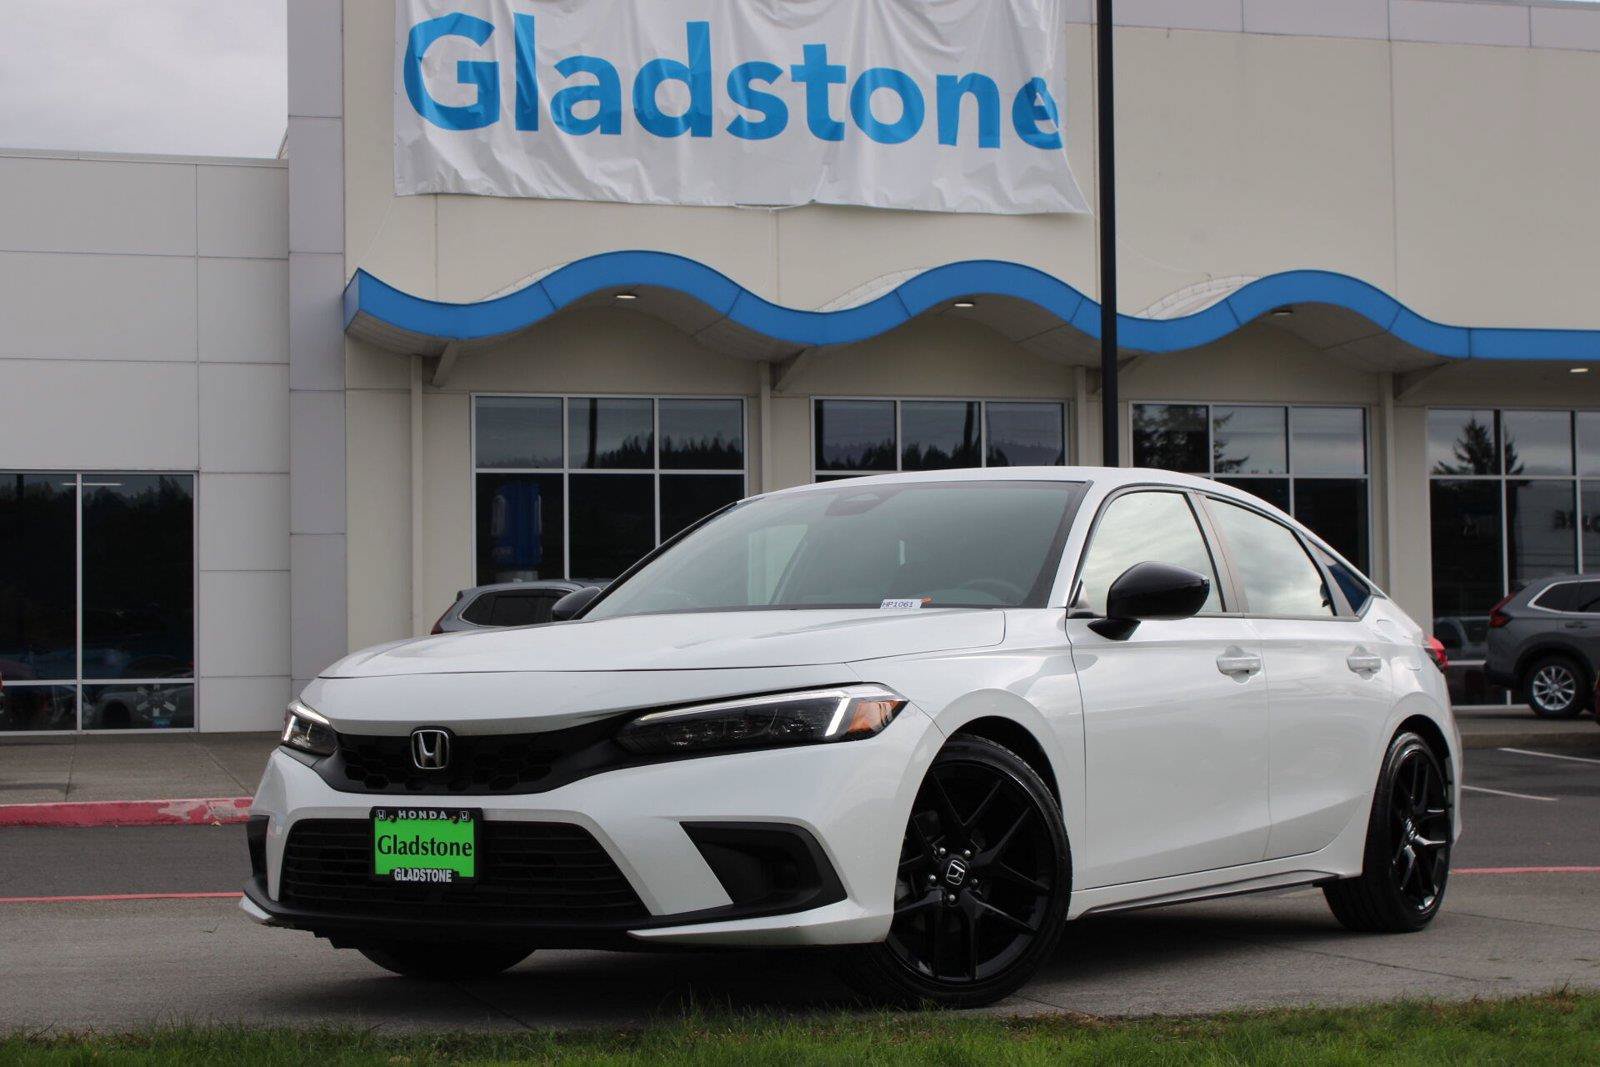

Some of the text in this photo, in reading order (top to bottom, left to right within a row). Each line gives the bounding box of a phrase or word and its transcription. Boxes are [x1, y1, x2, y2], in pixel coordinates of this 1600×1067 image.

[404, 12, 1063, 150] Gladstone
[398, 810, 448, 820] HONDA
[377, 834, 473, 857] Gladstone
[394, 868, 453, 882] GLADSTONE
